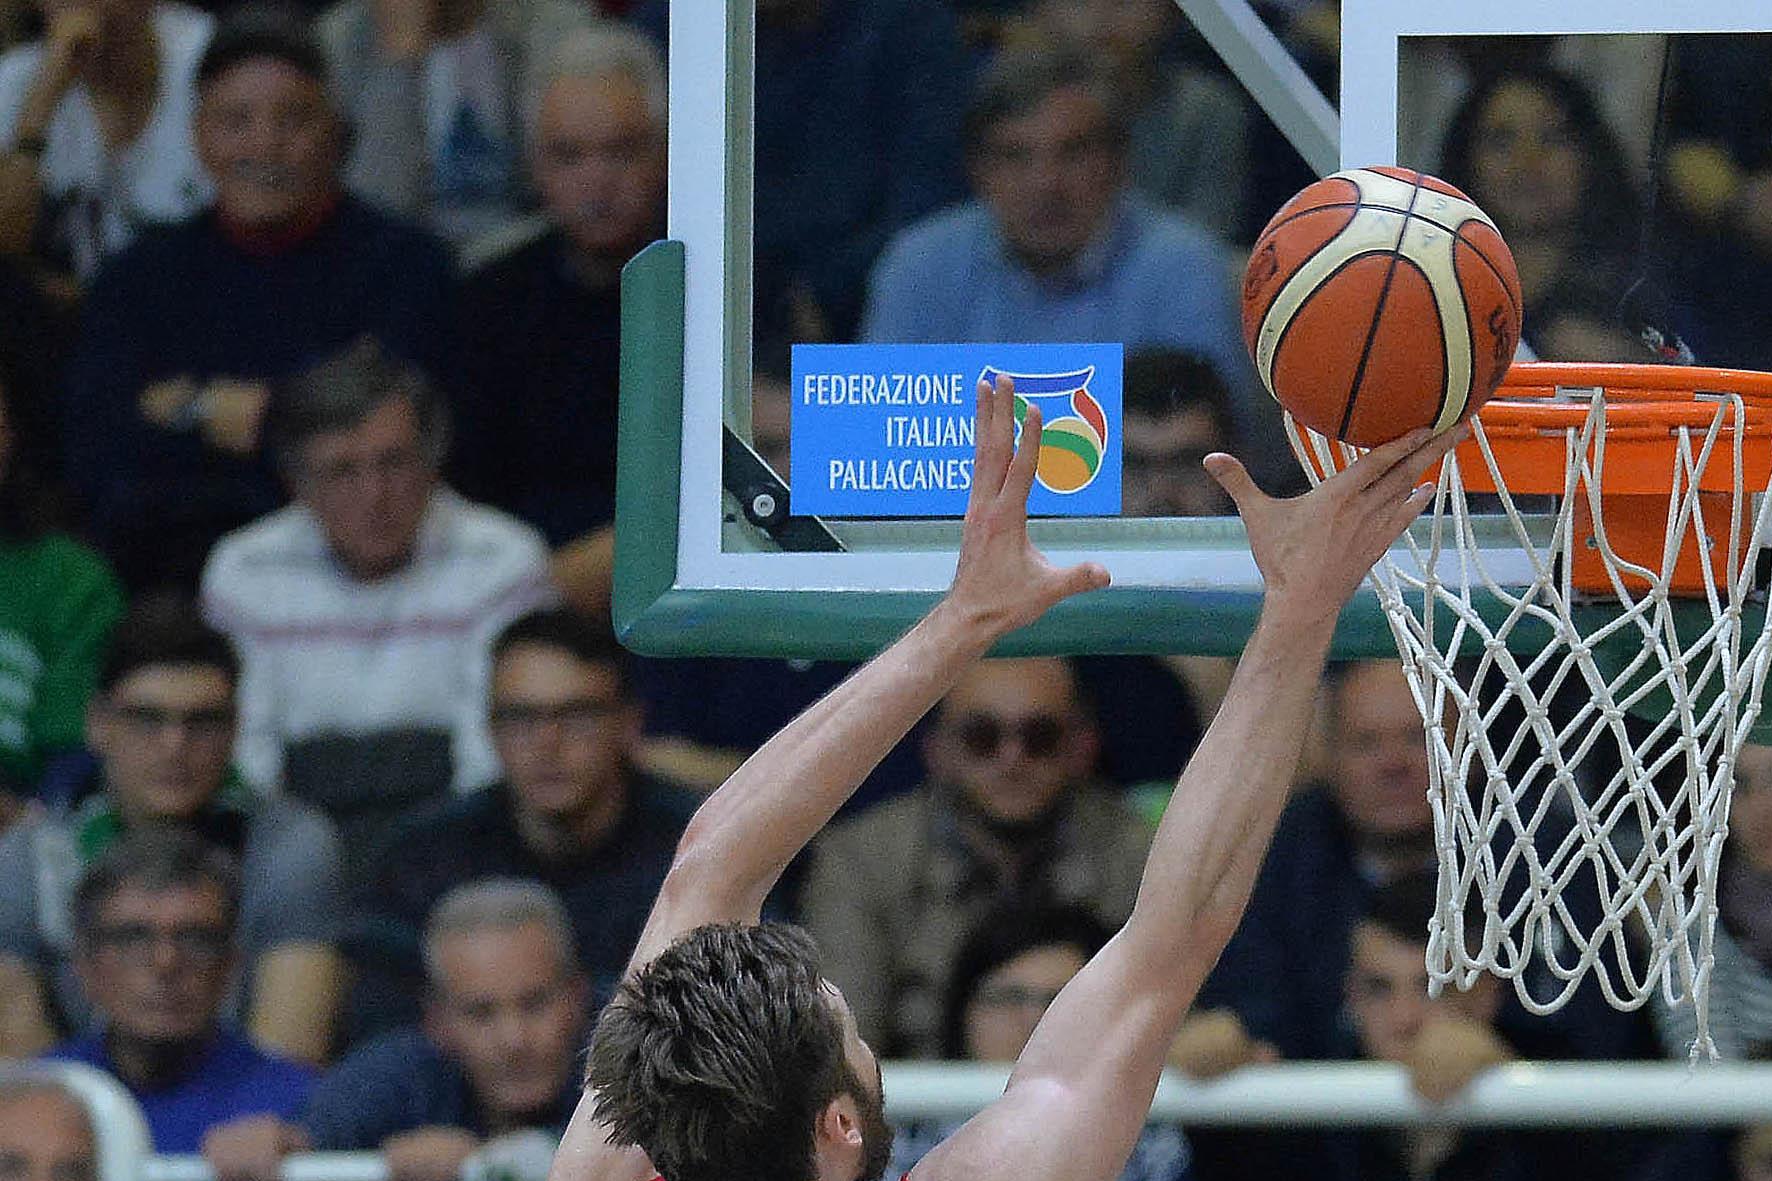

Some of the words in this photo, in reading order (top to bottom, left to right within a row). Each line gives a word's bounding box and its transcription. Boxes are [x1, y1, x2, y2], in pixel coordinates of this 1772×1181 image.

[803, 374, 963, 405] FEDERAZIONE
[887, 416, 976, 448] ITALIAN
[829, 459, 975, 490] PALLACANES
